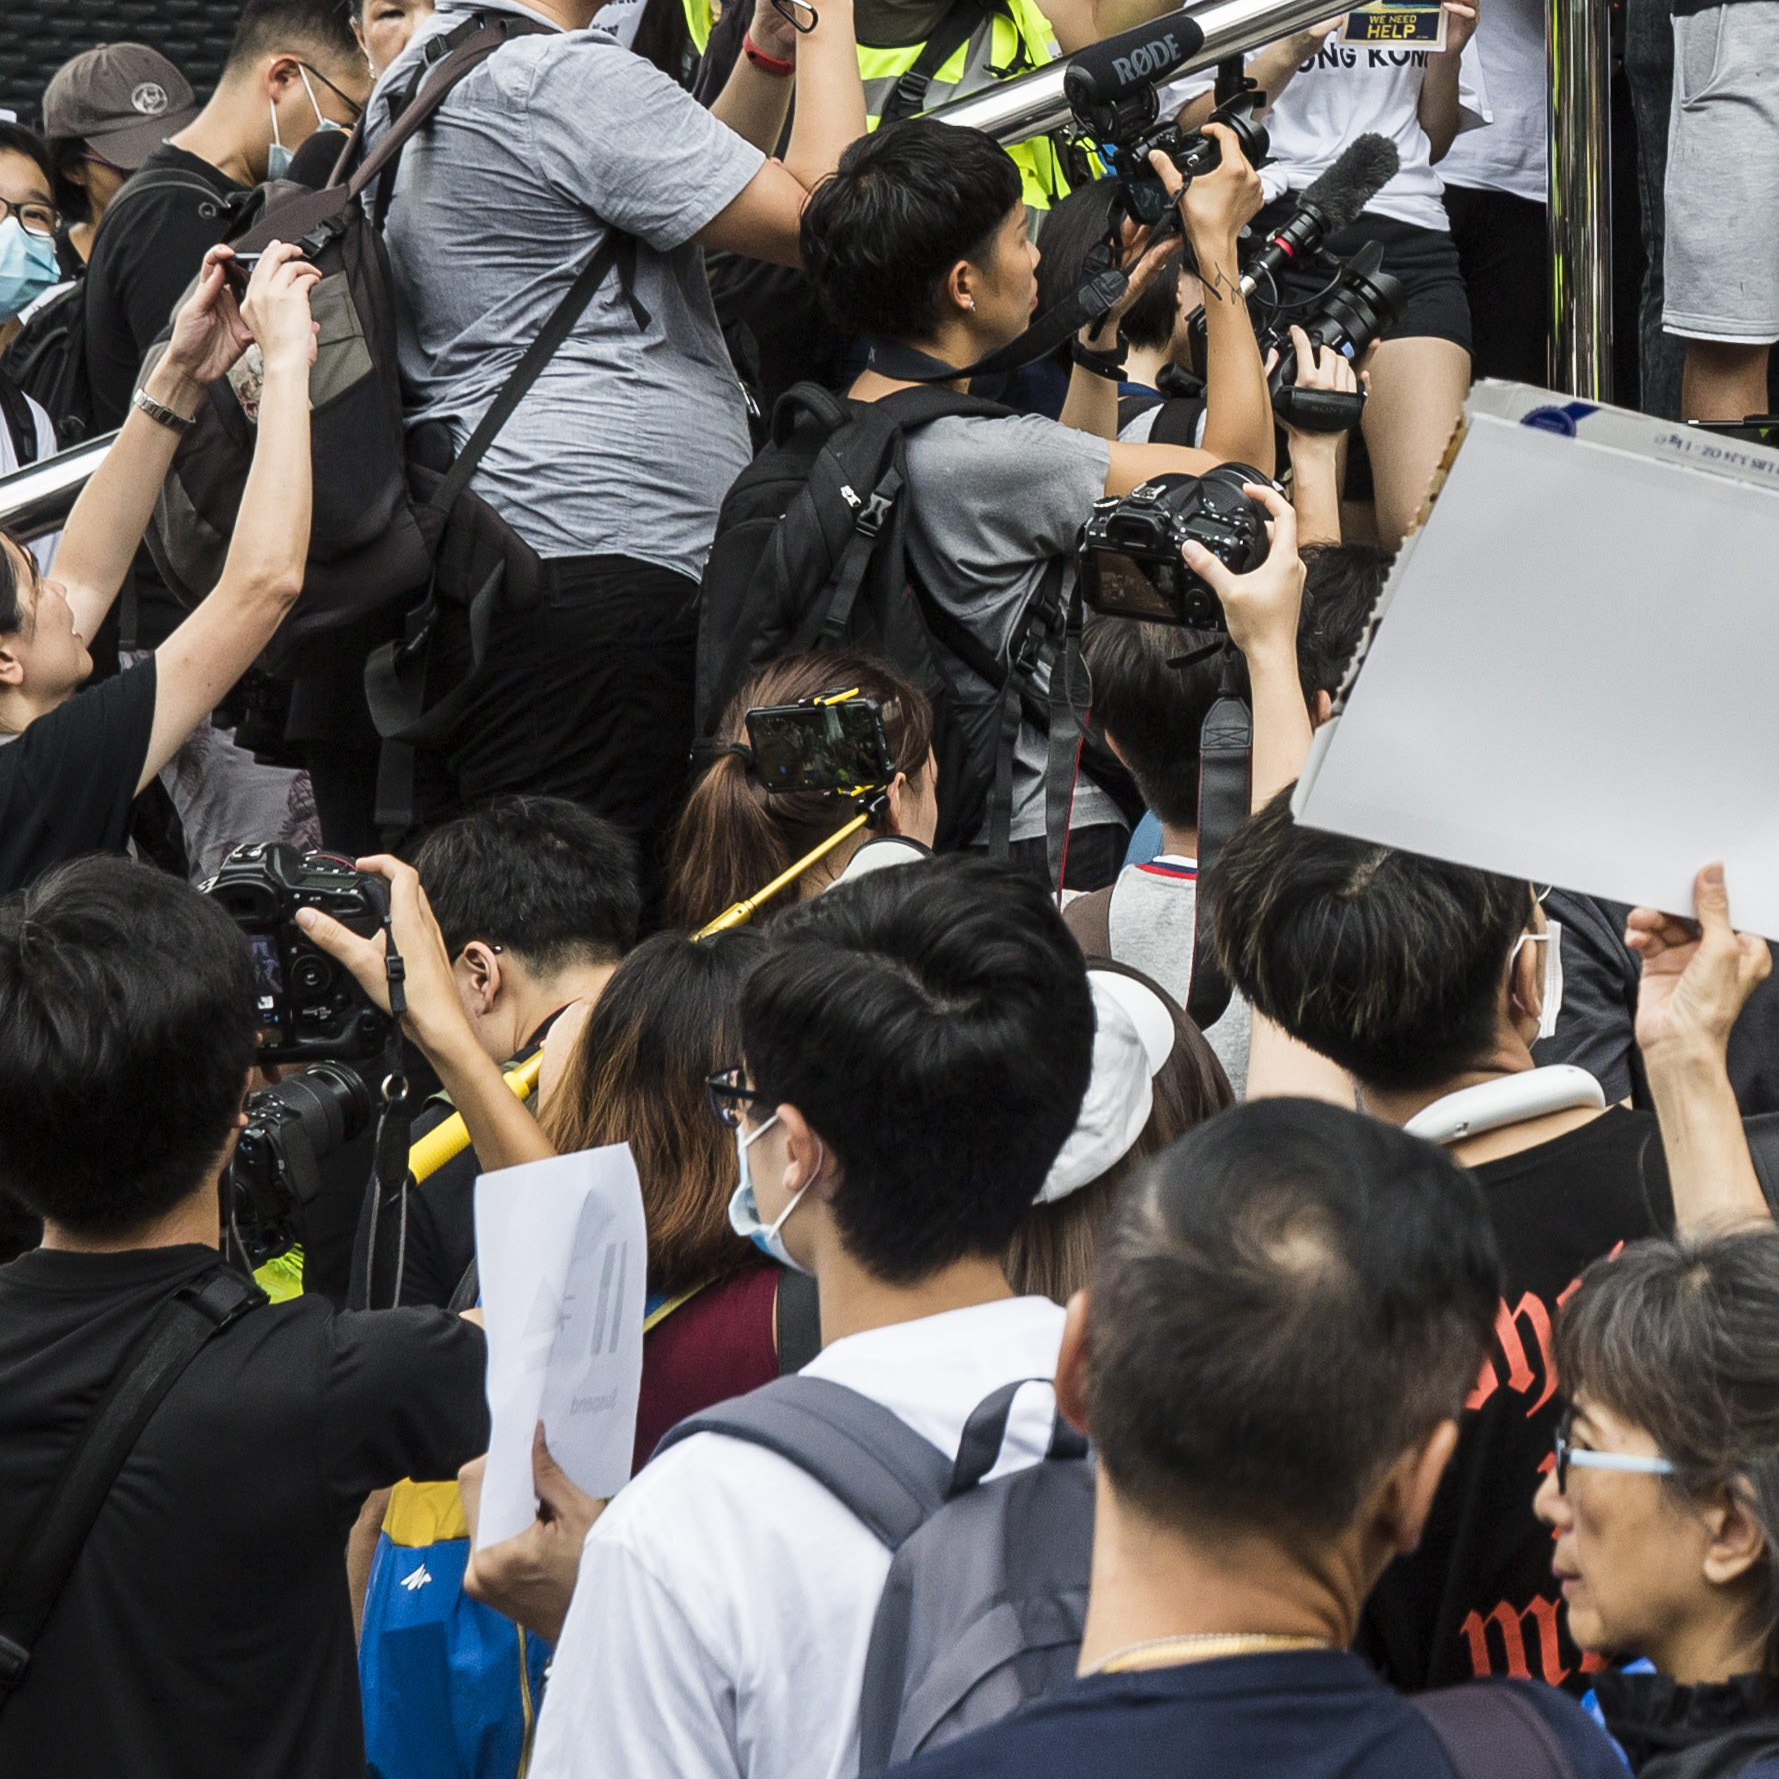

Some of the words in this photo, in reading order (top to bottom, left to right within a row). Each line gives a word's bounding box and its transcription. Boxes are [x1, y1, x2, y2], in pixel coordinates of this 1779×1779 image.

[1369, 14, 1387, 24] WE
[1388, 14, 1418, 24] NEED
[1366, 24, 1417, 40] HELP
